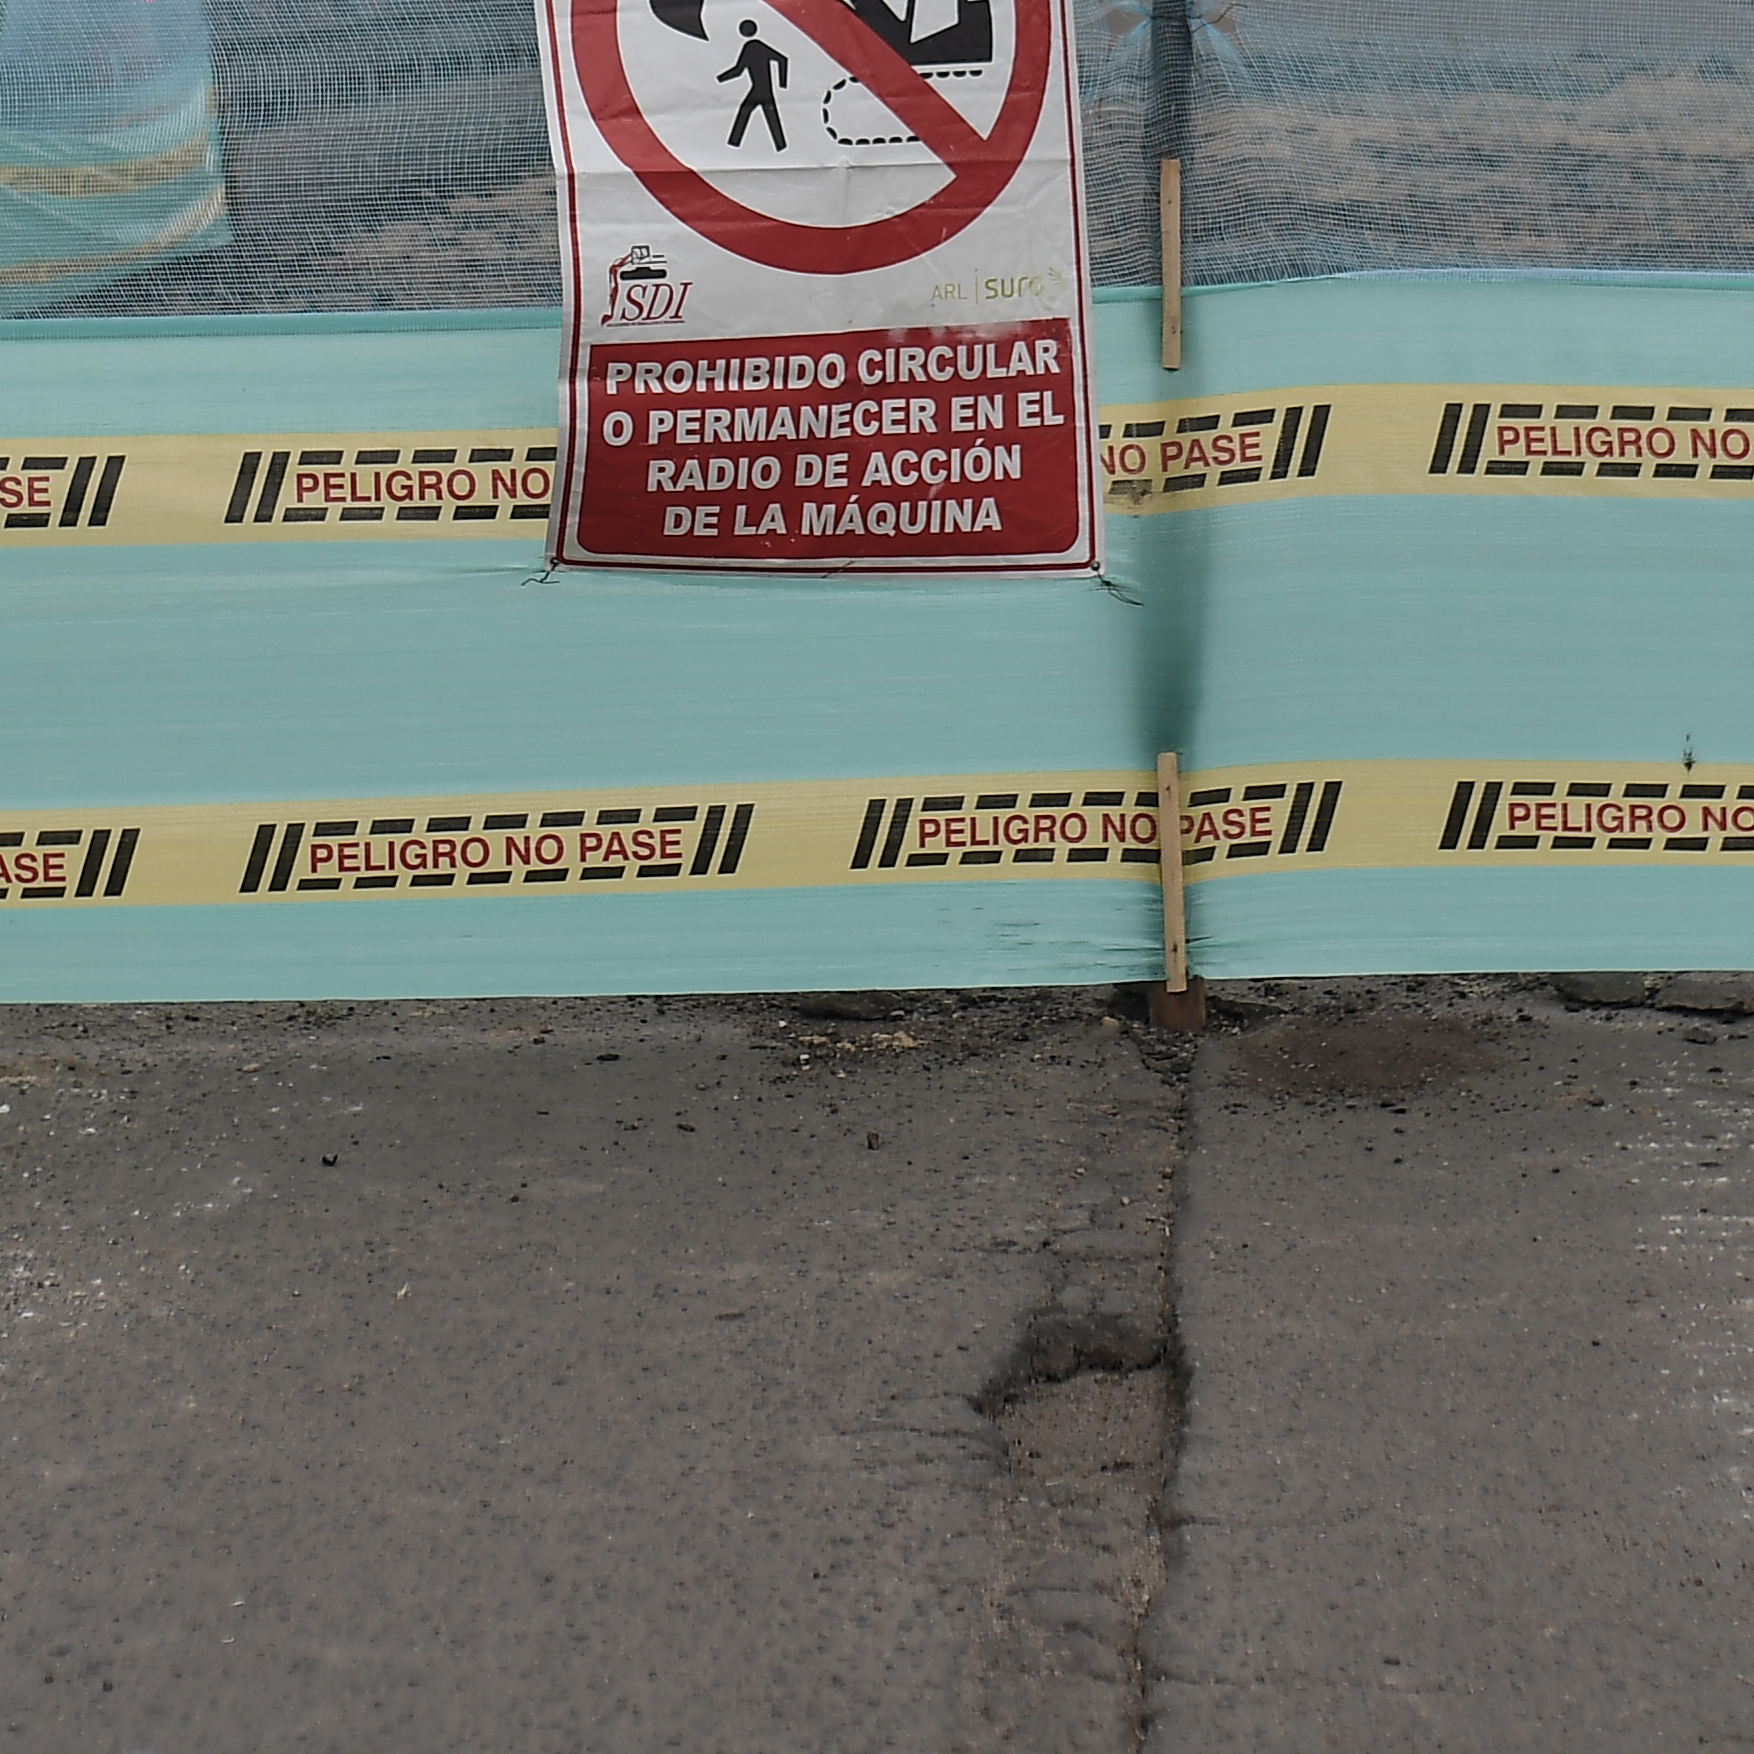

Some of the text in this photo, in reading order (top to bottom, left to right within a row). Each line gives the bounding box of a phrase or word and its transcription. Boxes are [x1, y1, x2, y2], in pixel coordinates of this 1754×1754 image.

[620, 282, 694, 321] SDI
[931, 283, 968, 301] ARL
[605, 339, 1061, 395] PROHIBIDO CIRCULAR
[602, 390, 1065, 446] O PERMANECER EN EL
[1161, 431, 1263, 472] PASE
[1497, 426, 1676, 459] PELIGRO
[1691, 428, 1751, 460] NO
[646, 438, 1022, 492] RADIO DE ACCIÓN
[296, 468, 550, 503] PELIGRO NO
[662, 495, 1002, 537] DE LA MÁQUINA
[918, 811, 1087, 848] PELIGRO
[1102, 812, 1158, 844] NO
[1508, 801, 1687, 834] PELIGRO
[310, 828, 683, 874] PELIGRO NO PASE
